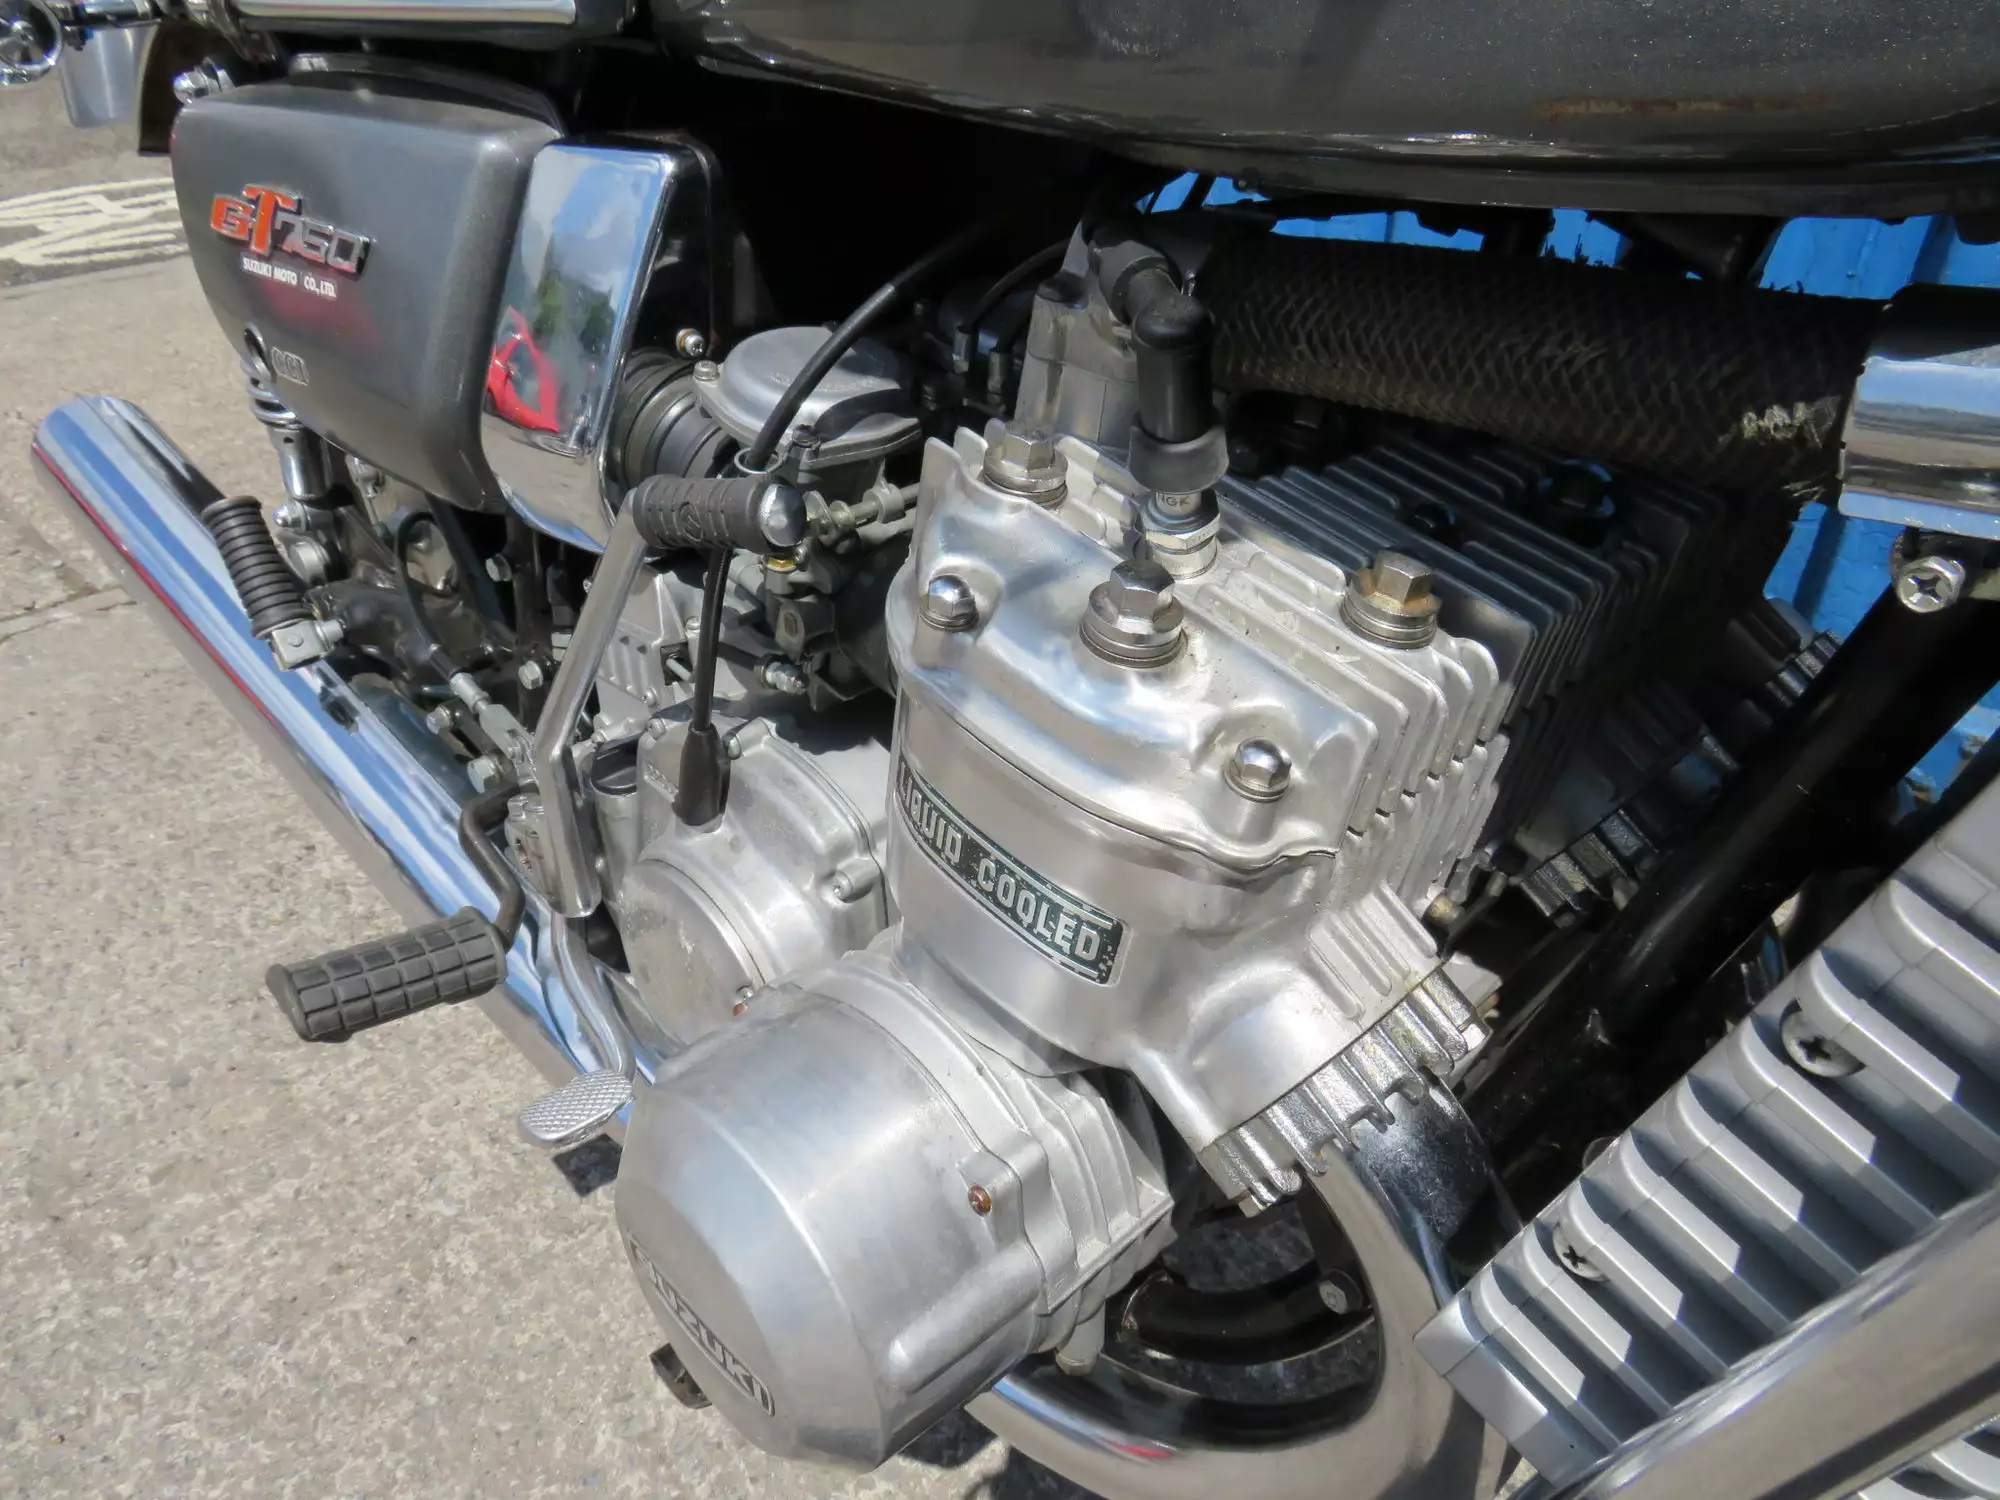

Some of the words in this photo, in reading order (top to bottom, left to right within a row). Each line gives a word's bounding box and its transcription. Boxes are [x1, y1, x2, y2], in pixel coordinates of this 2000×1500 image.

[210, 184, 371, 273] GT750
[242, 257, 272, 277] SUZUKI
[899, 761, 962, 864] LIQUID
[977, 857, 1101, 961] COOLED
